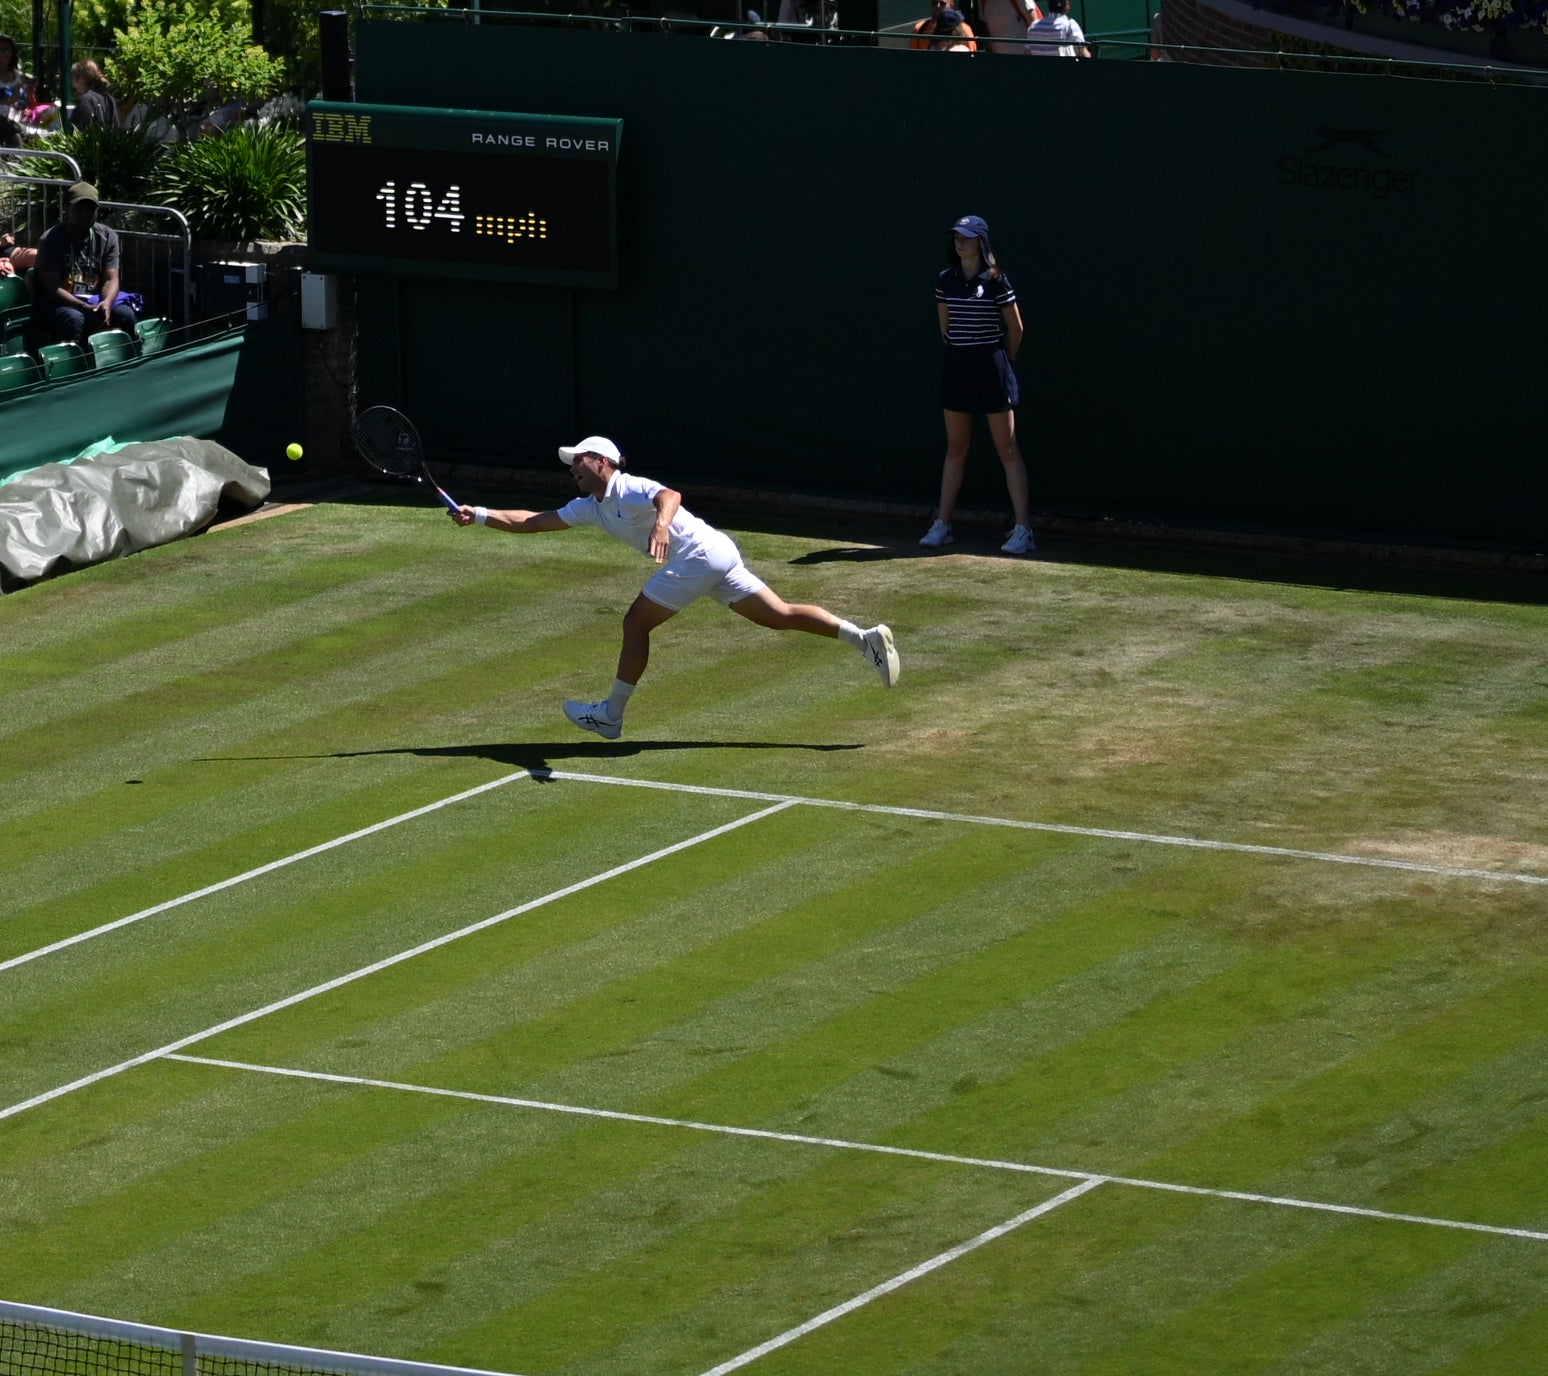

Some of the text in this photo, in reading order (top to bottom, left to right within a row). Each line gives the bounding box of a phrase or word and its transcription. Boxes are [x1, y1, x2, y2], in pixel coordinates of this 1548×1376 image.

[312, 112, 372, 144] IBM
[472, 132, 610, 152] RANGE ROVER
[1277, 154, 1419, 199] Slazenger
[375, 180, 548, 244] 104 mph
